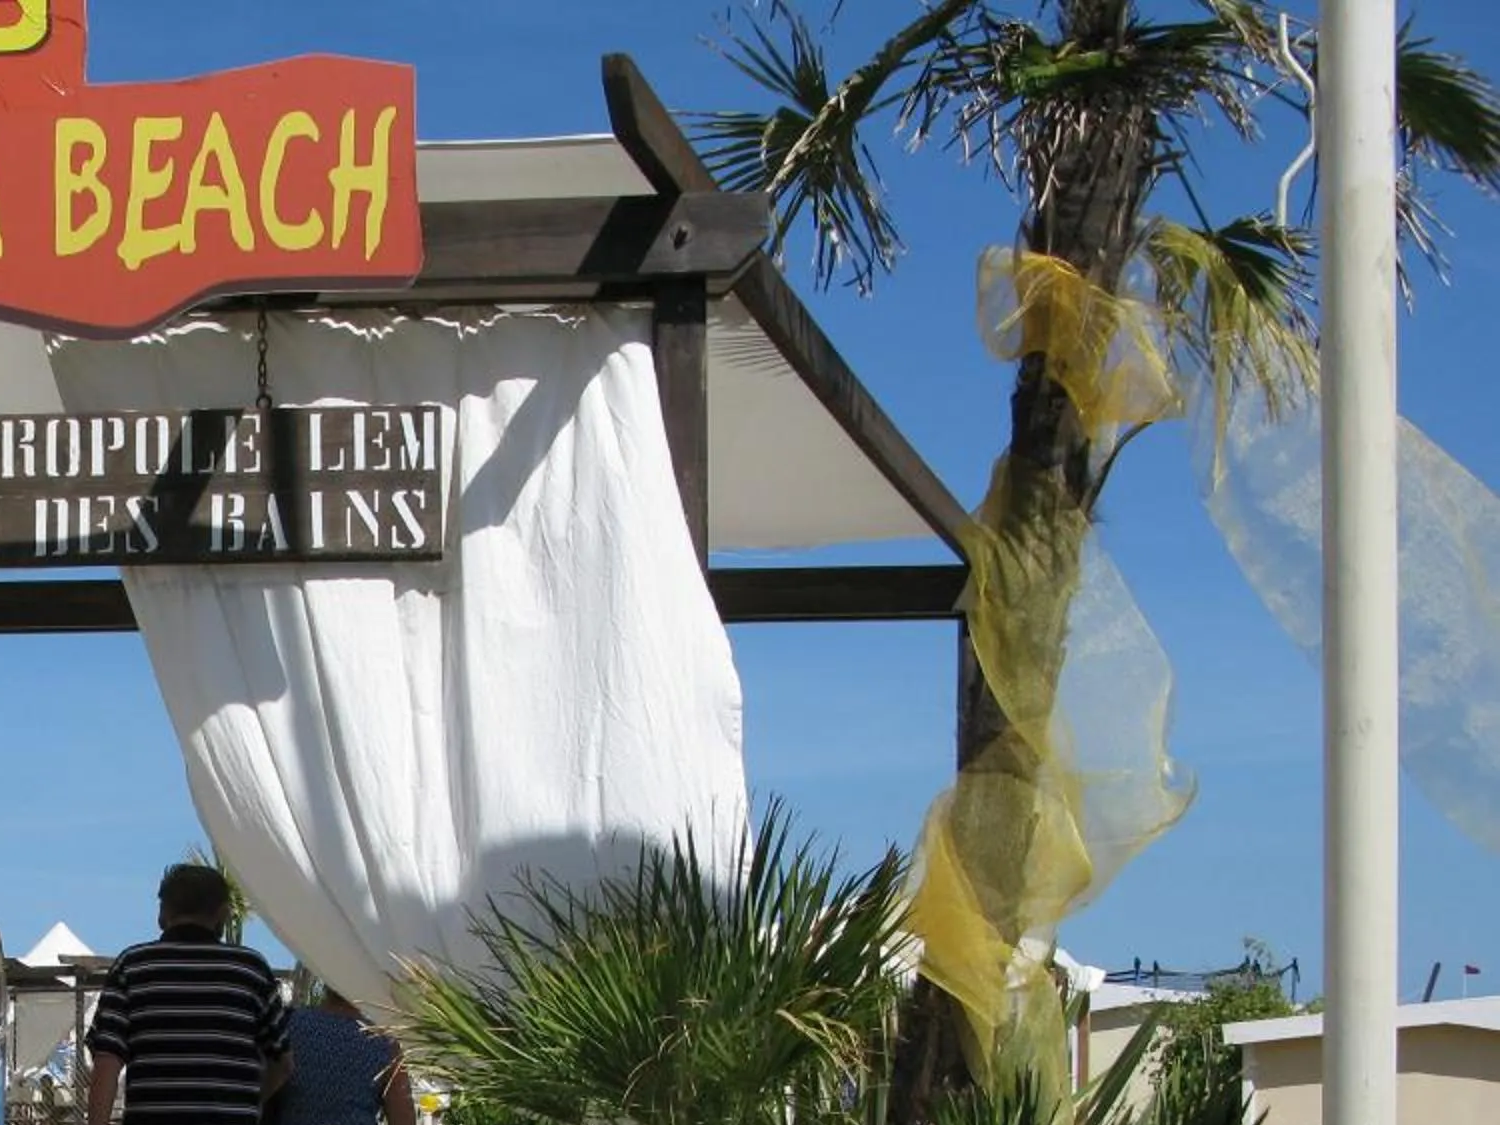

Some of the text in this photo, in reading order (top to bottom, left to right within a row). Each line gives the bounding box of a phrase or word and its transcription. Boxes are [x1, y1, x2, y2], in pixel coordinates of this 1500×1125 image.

[55, 106, 397, 270] BEACH
[309, 410, 438, 472] LEM
[34, 495, 160, 557] DES
[209, 488, 428, 555] BAINS
